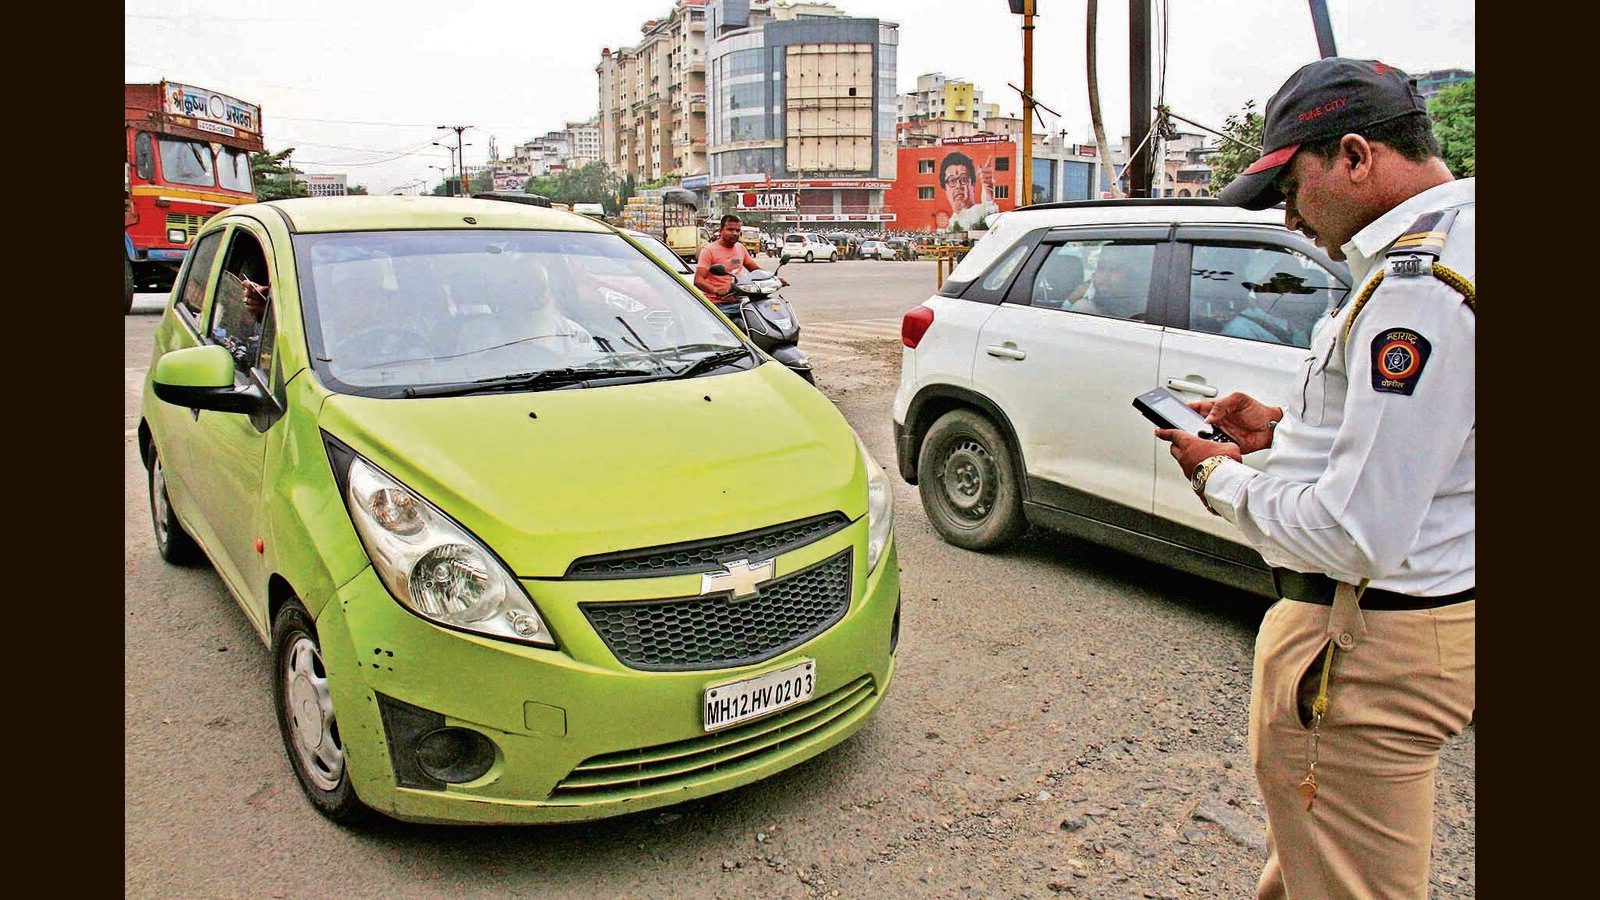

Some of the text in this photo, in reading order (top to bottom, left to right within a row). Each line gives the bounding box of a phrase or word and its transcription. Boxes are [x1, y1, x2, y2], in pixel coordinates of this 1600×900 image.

[1298, 97, 1347, 123] PUNE CITY
[736, 192, 796, 208] I KATRAJ
